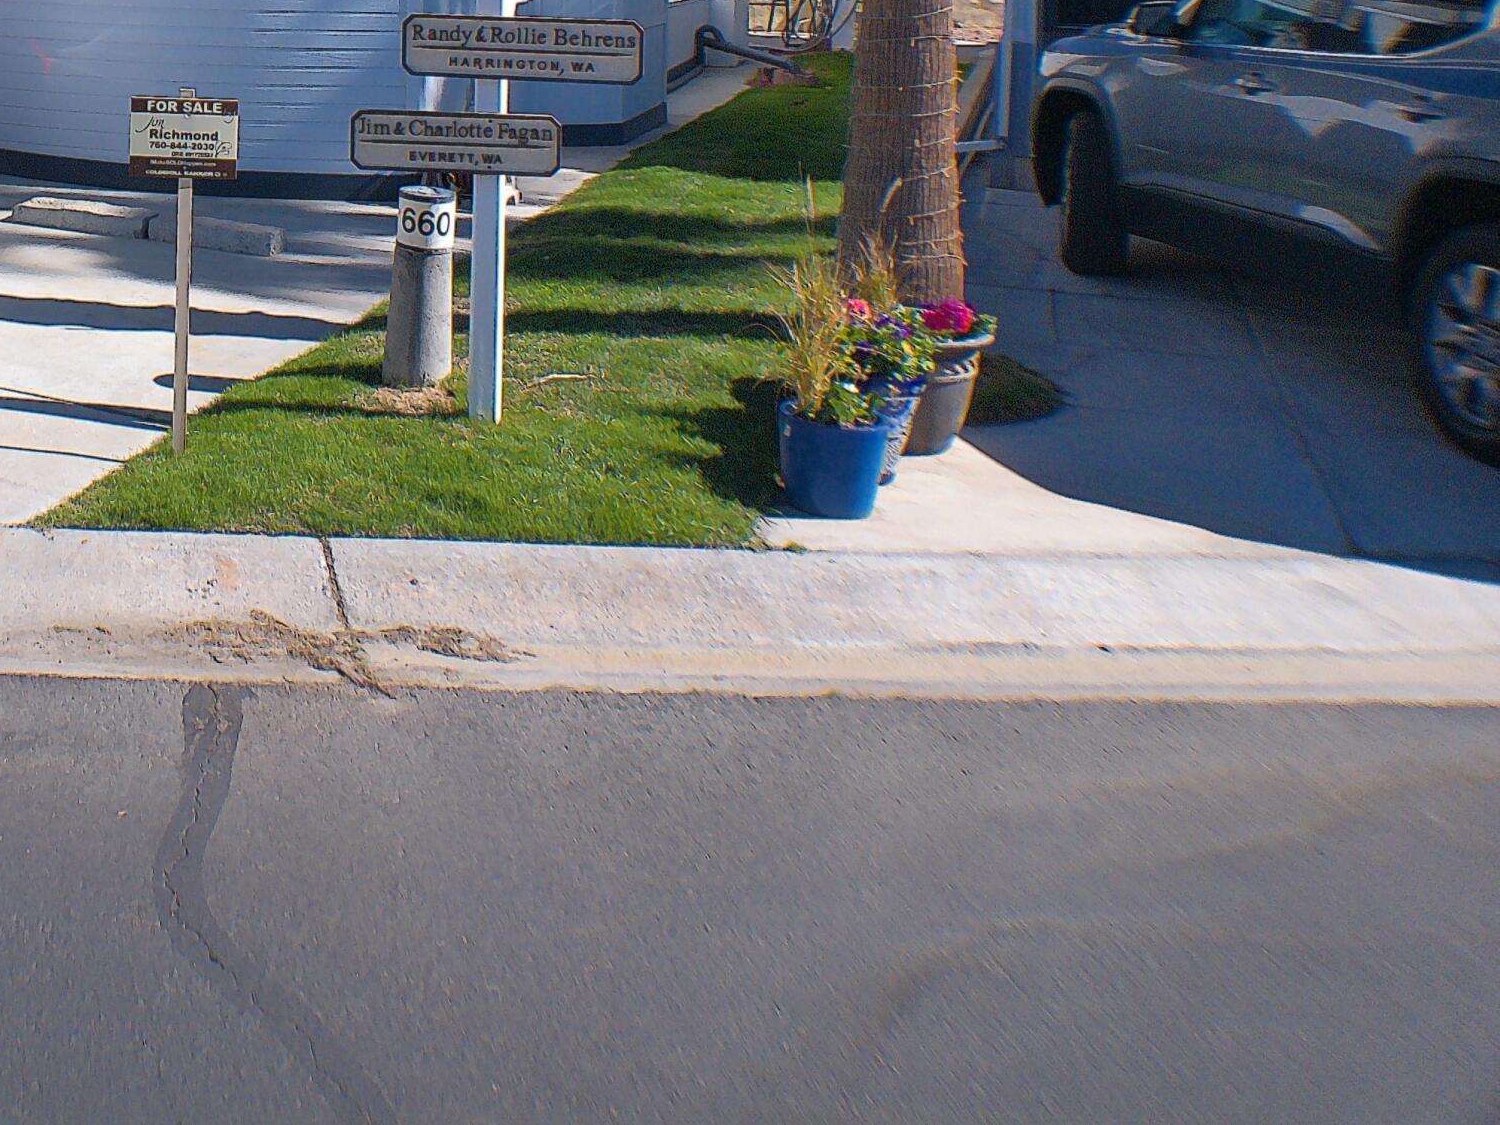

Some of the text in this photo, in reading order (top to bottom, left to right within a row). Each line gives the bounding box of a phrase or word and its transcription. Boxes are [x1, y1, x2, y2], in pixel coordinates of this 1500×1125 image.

[411, 24, 637, 49] Randy & Rollie Behrens
[448, 56, 597, 76] HARRINGTON, WA
[147, 100, 223, 114] FOR SALE
[149, 128, 219, 141] Richmond
[357, 116, 554, 144] Jim & Charlotte Fagan
[148, 141, 215, 151] 760-844-2030
[408, 150, 503, 166] EVERETT, WA
[402, 207, 451, 236] 660
